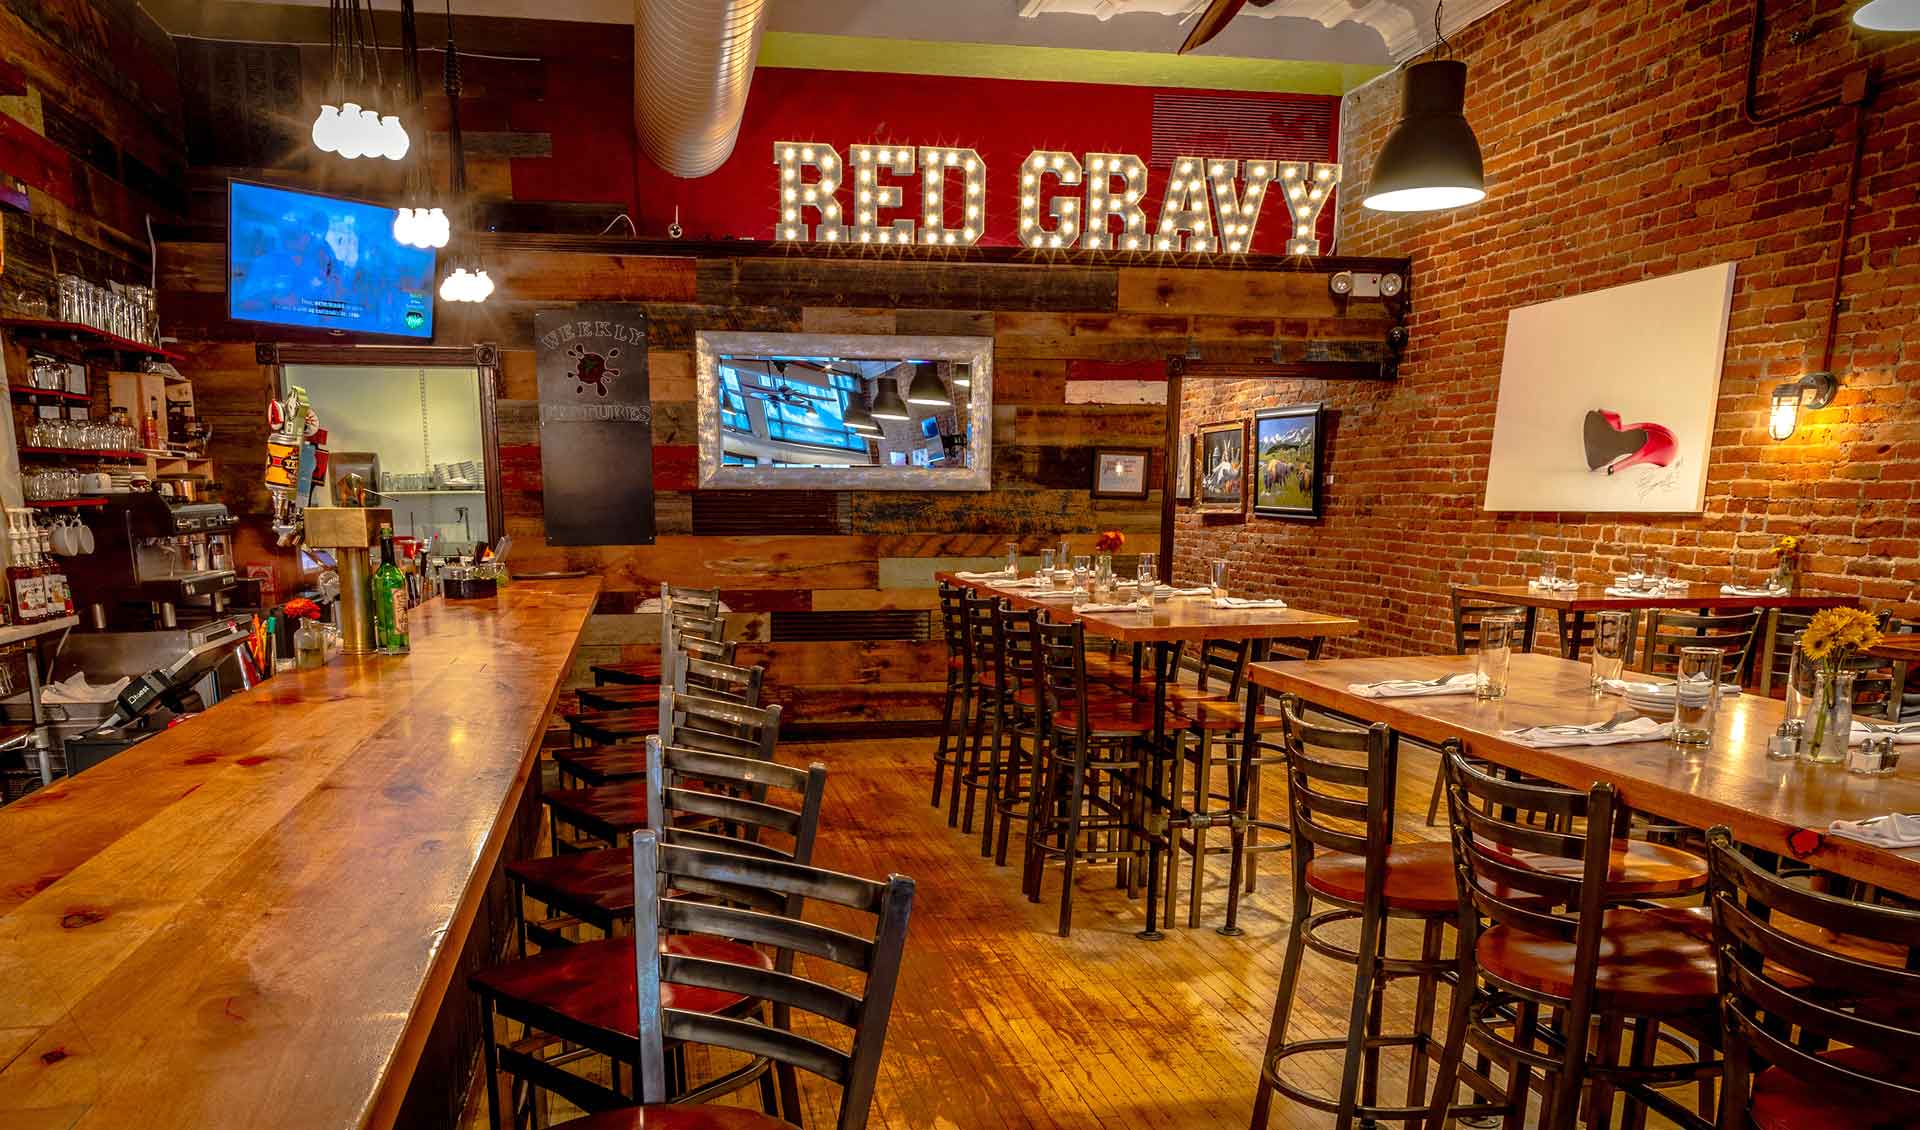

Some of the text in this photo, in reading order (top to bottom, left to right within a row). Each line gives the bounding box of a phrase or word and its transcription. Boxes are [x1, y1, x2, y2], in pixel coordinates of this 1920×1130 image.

[774, 141, 1342, 256] RED GRAVY
[542, 321, 646, 350] WEEKLY
[541, 403, 651, 421] TURES
